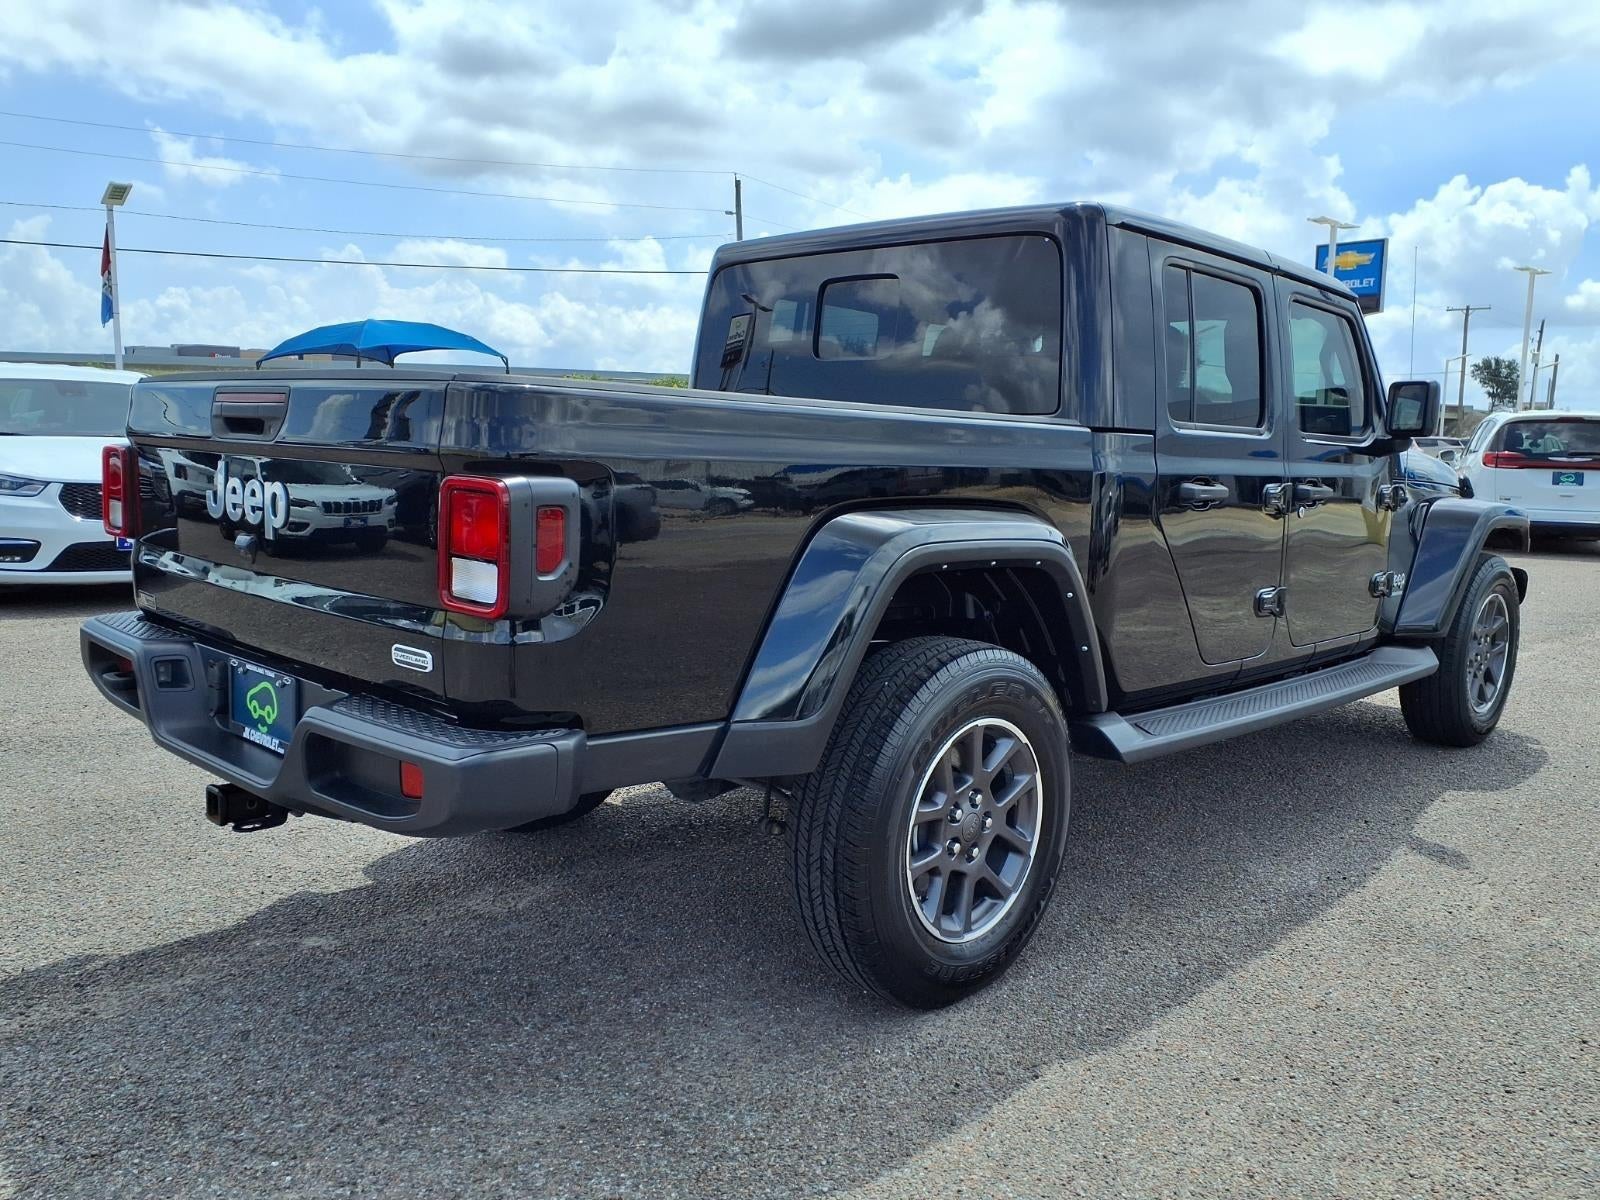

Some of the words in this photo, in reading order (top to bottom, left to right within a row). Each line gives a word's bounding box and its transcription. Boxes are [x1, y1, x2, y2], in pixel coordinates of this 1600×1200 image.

[1342, 278, 1376, 288] ROLET
[206, 460, 289, 540] Jeep
[394, 651, 429, 665] OVERLAND
